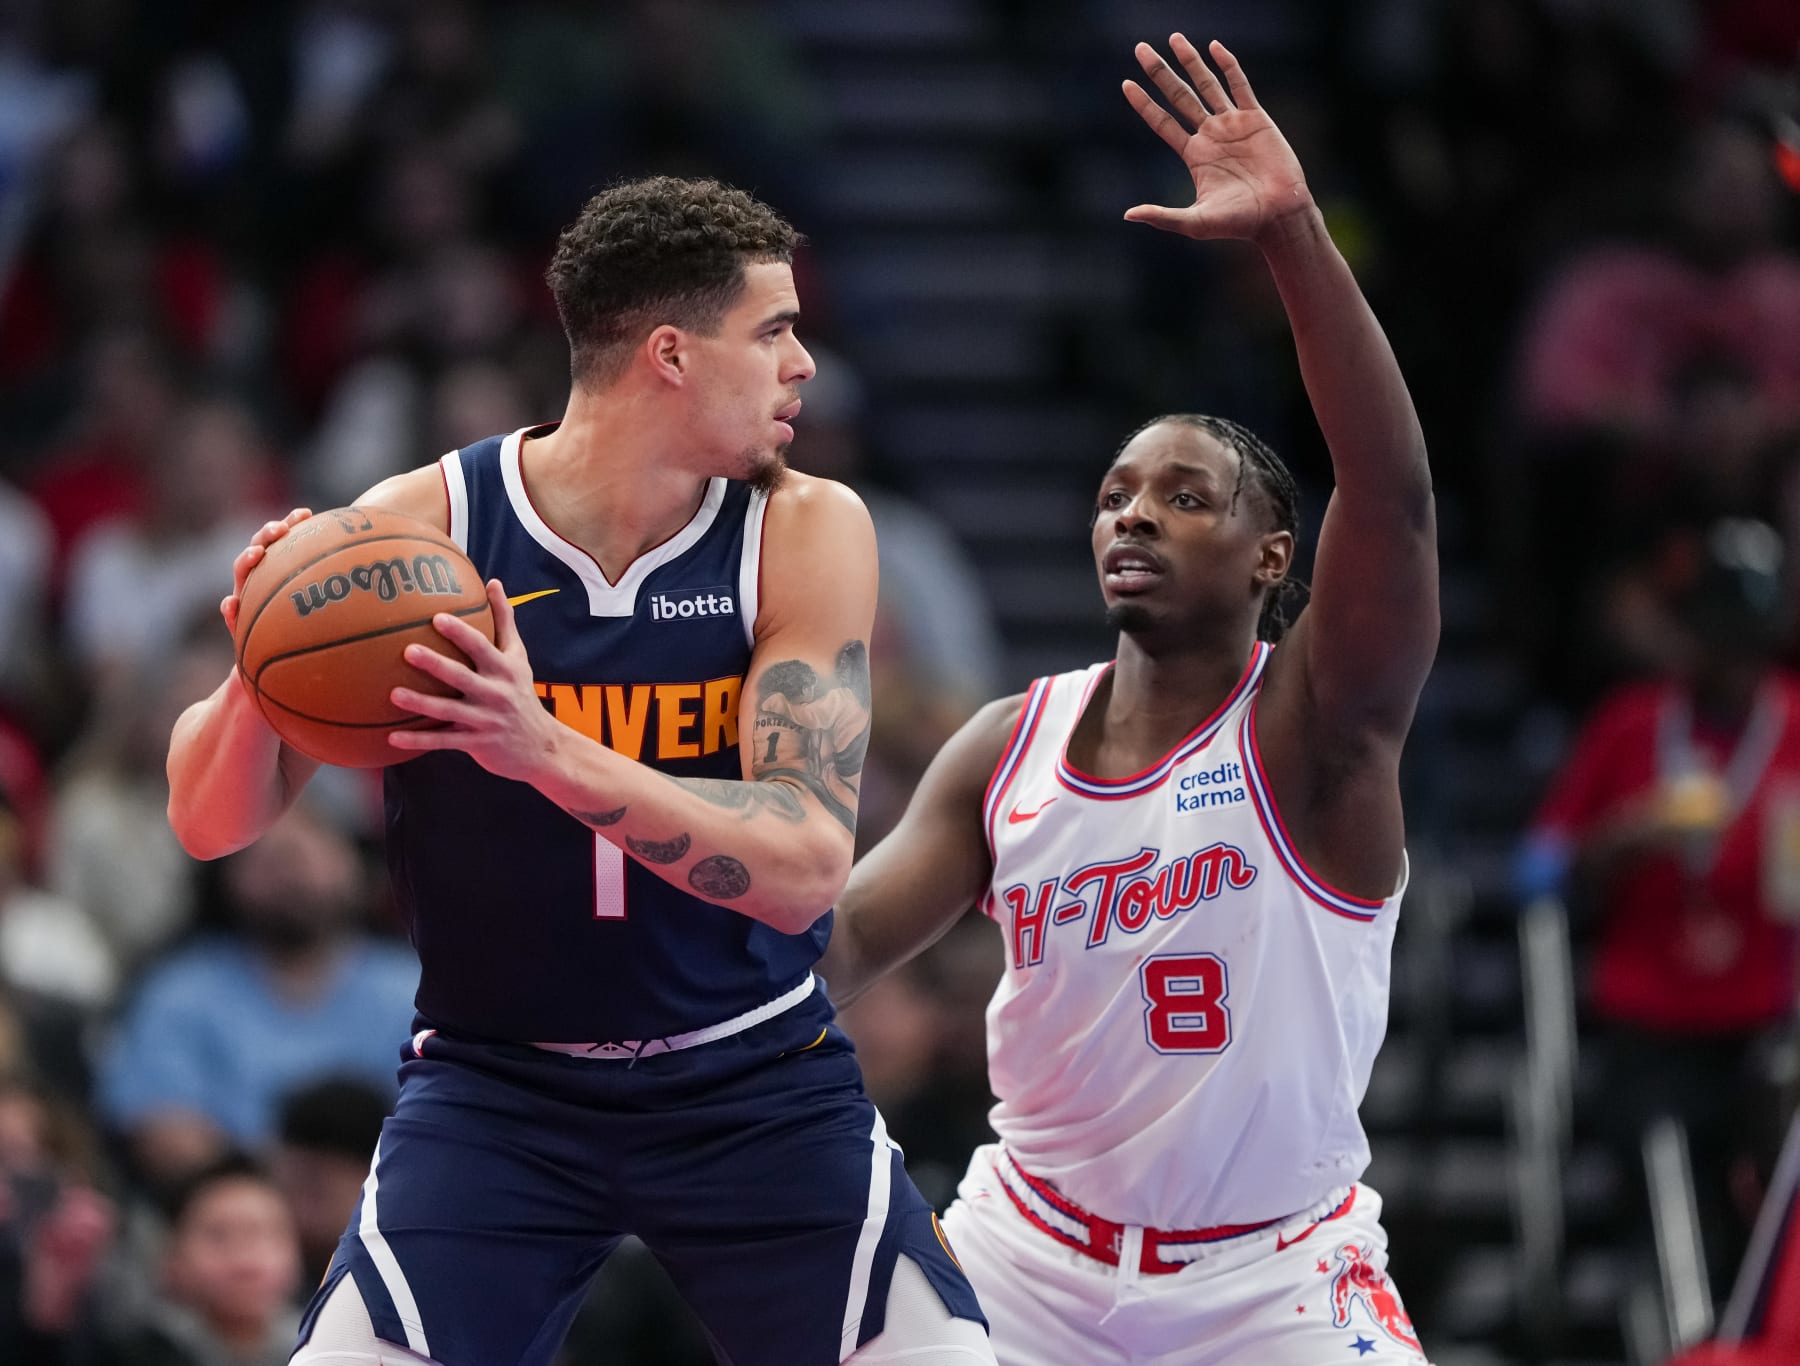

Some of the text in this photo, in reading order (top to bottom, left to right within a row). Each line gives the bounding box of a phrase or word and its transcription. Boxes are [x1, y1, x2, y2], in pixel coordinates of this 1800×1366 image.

[290, 554, 464, 618] Wilson
[651, 593, 734, 620] ibotta
[532, 673, 743, 761] NVER
[763, 731, 781, 764] 1
[1176, 786, 1246, 813] karma
[1179, 762, 1242, 791] credit
[1002, 841, 1258, 970] H-Town
[1139, 952, 1233, 1056] 8
